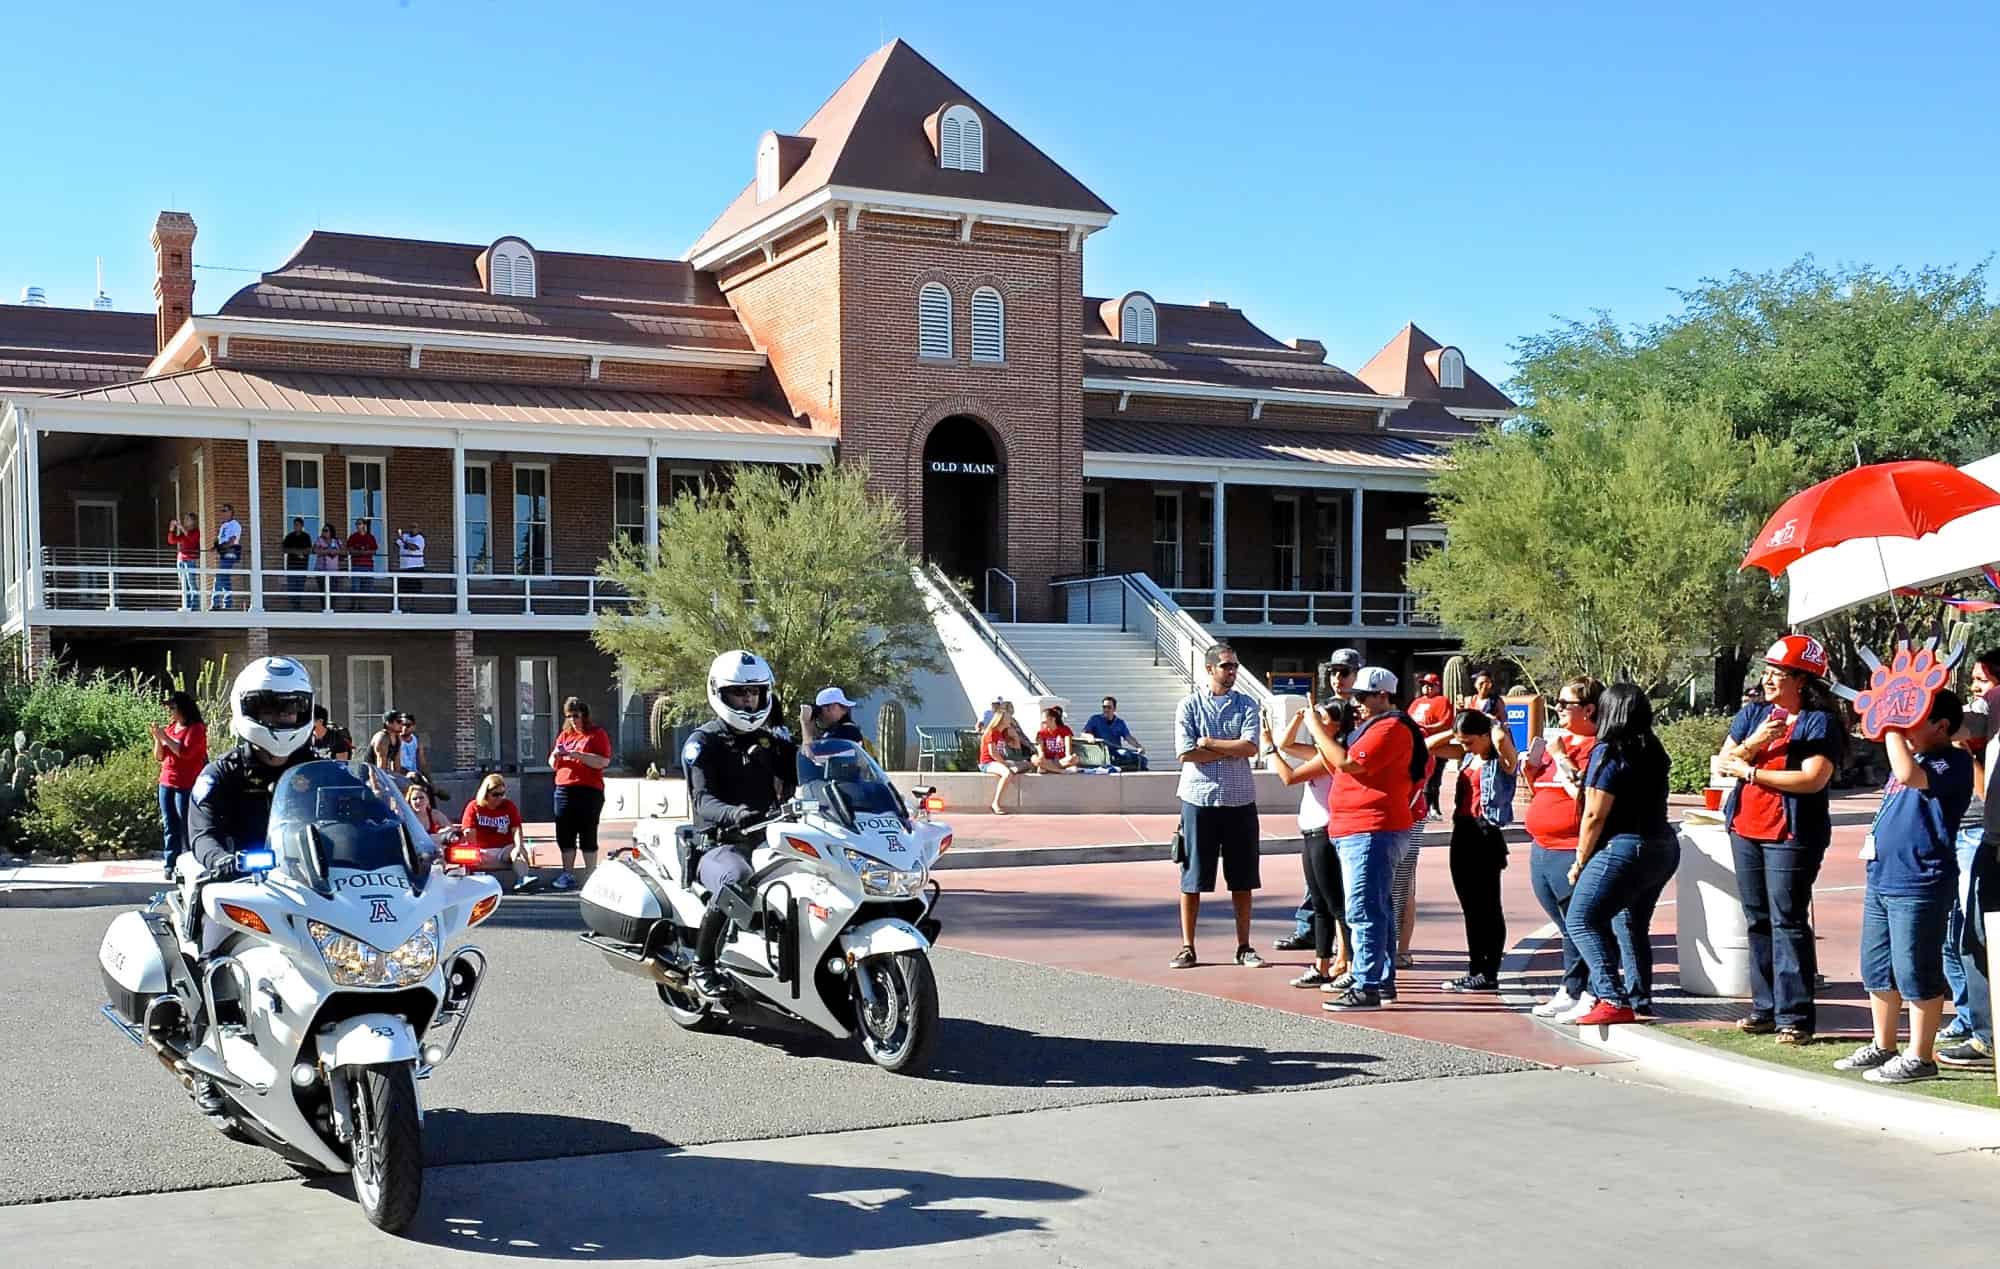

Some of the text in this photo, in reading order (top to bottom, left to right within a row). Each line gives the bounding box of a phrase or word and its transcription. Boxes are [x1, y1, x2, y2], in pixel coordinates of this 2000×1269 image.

[932, 462, 995, 474] OLD MAIN
[334, 872, 409, 892] POLICE
[369, 899, 398, 923] A
